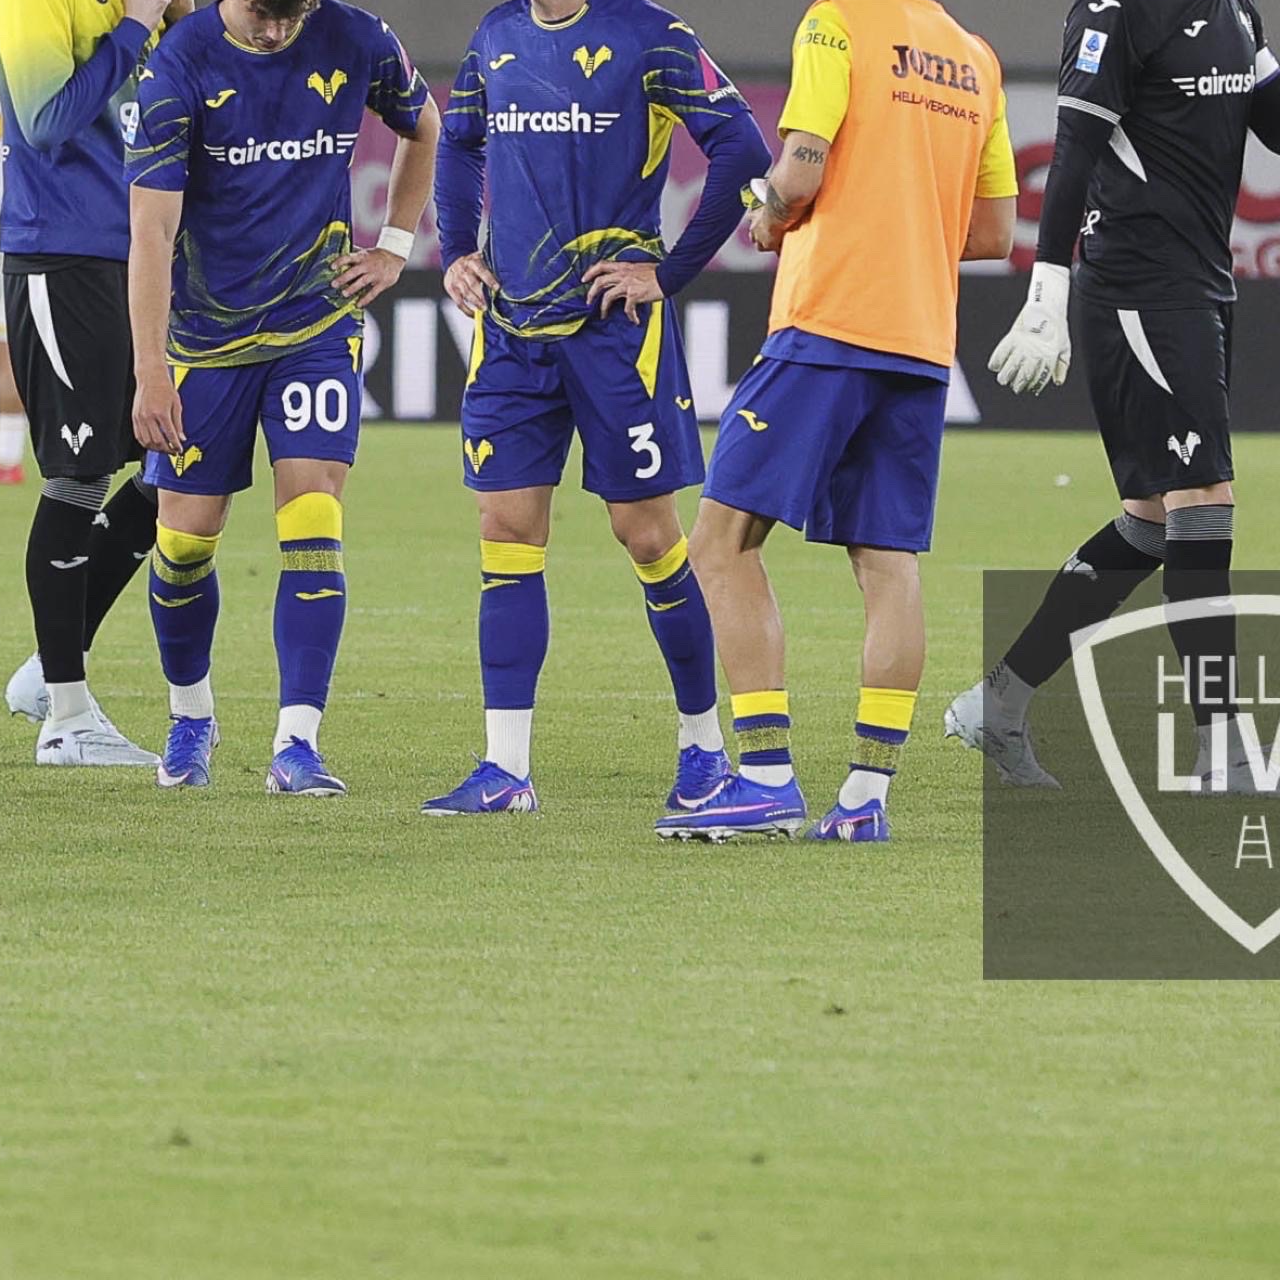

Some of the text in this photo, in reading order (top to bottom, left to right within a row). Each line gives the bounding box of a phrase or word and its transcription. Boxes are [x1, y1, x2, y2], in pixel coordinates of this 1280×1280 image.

[496, 102, 593, 133] aircash
[925, 99, 966, 119] VERONA
[228, 129, 334, 166] aircash
[282, 379, 348, 432] 90
[628, 423, 662, 479] 3
